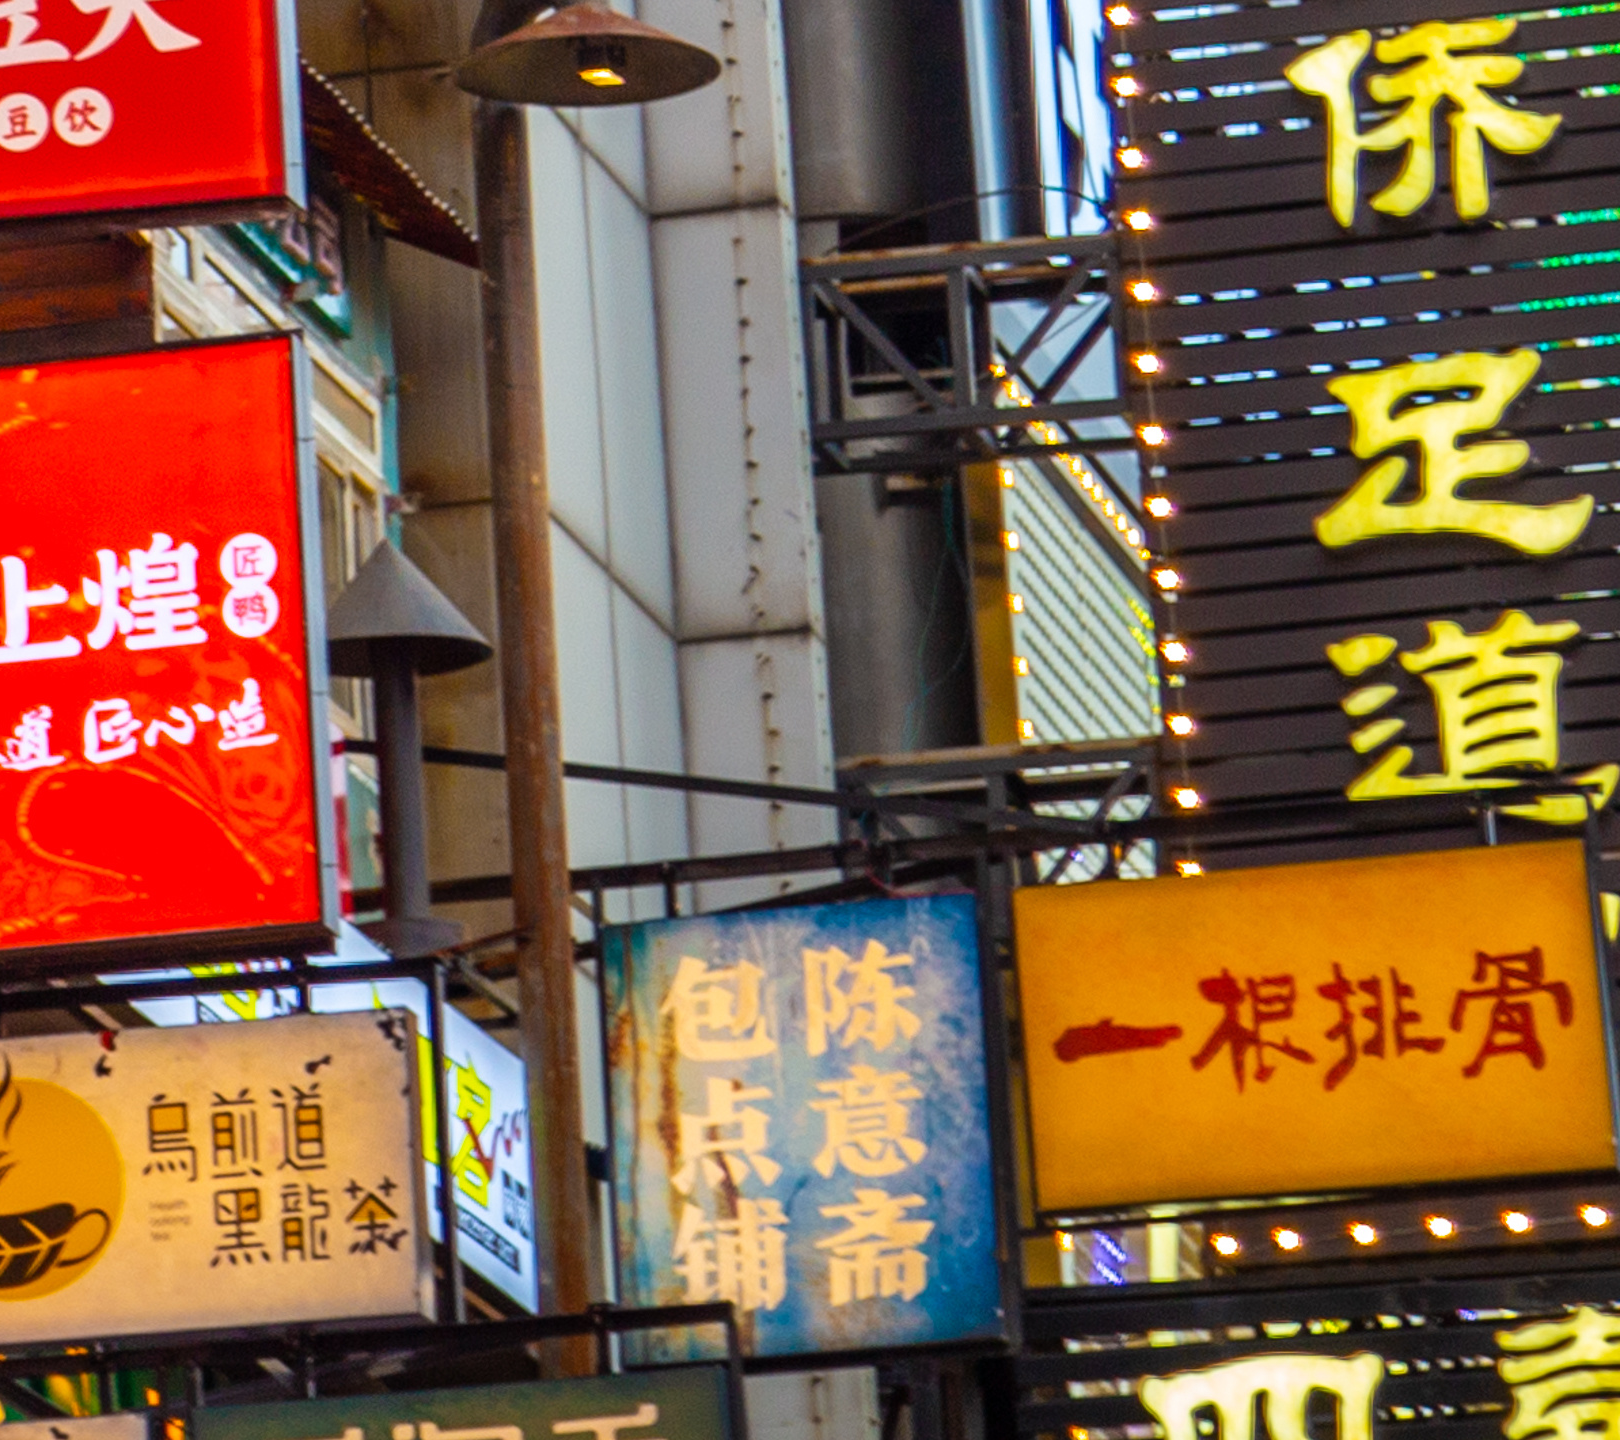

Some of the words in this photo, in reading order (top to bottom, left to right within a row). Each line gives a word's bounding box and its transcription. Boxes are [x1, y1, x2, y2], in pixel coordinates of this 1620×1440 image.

[660, 954, 789, 1312] 包点铺
[800, 937, 932, 1304] 陈意斋
[1051, 944, 1575, 1096] 一根排骨
